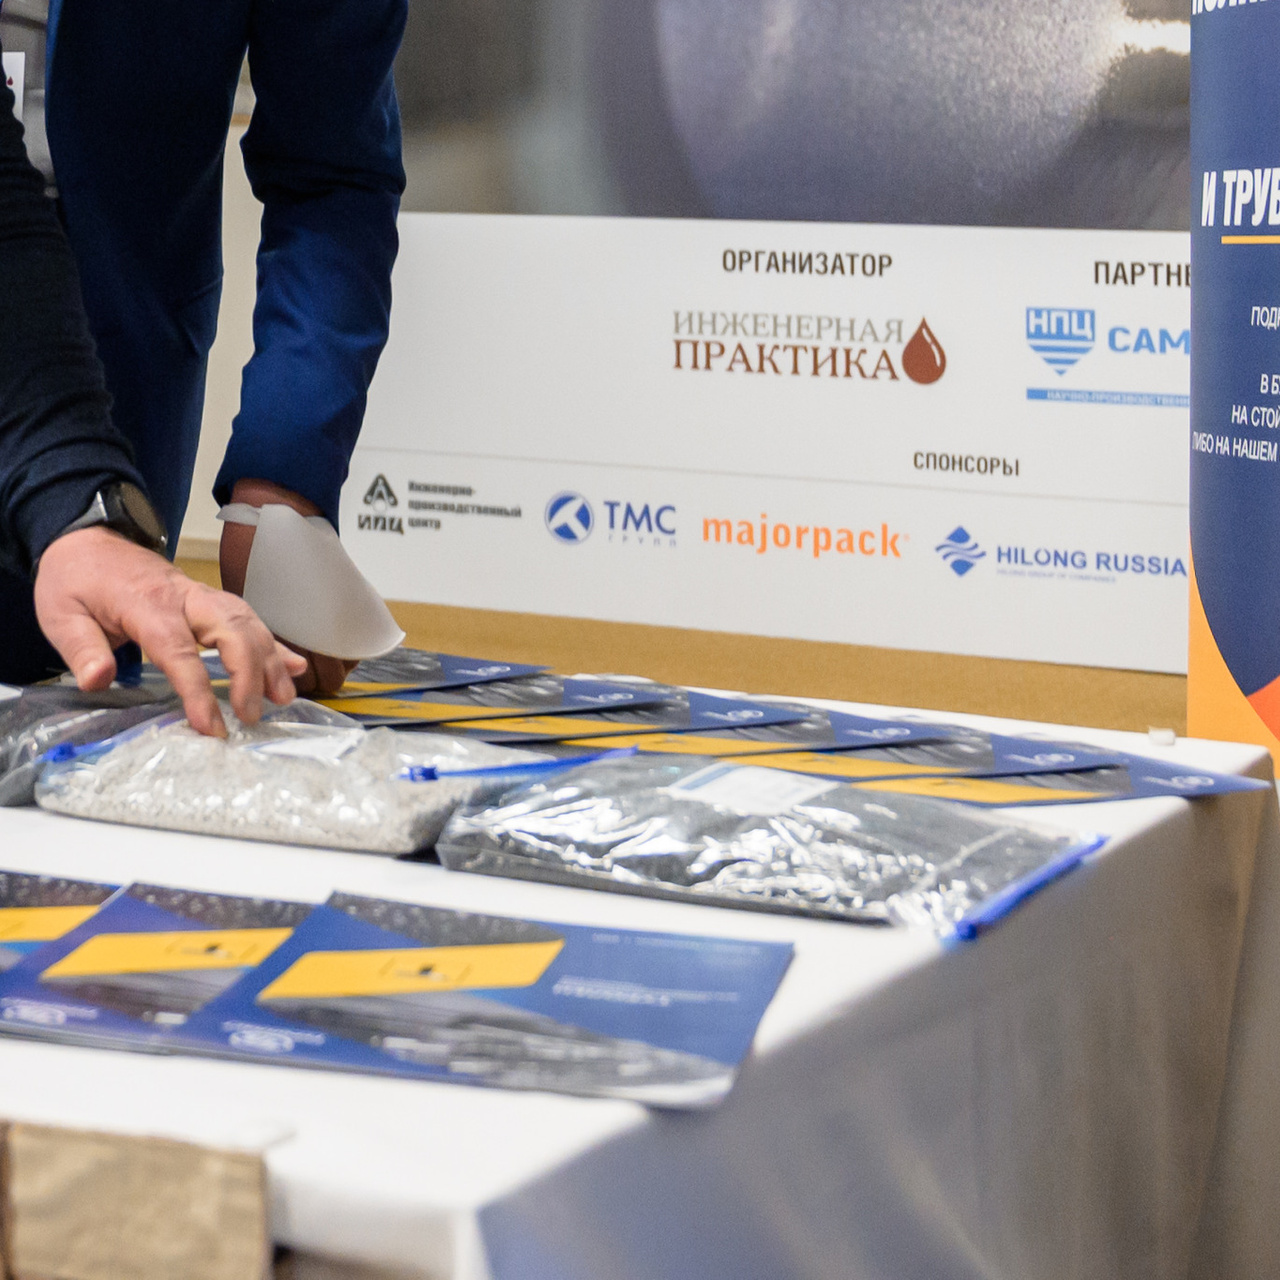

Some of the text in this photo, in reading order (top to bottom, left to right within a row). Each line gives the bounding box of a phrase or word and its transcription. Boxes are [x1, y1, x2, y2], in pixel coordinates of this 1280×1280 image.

[1201, 170, 1217, 227] И
[721, 249, 894, 277] ОРГАНИЗАТОР
[673, 310, 904, 344] ИНЖЕНЕРНАЯ
[1028, 309, 1093, 340] НПЦ
[673, 339, 901, 382] ПРАКТИКА
[1260, 373, 1269, 394] В
[1231, 404, 1248, 425] НА
[914, 451, 1020, 477] СПОНСОРЫ
[1215, 435, 1230, 456] НА
[1232, 437, 1278, 462] НАШЕМ
[603, 500, 676, 536] ТМС
[702, 512, 901, 559] majorpack
[997, 545, 1188, 577] HILONG RUSSIA
